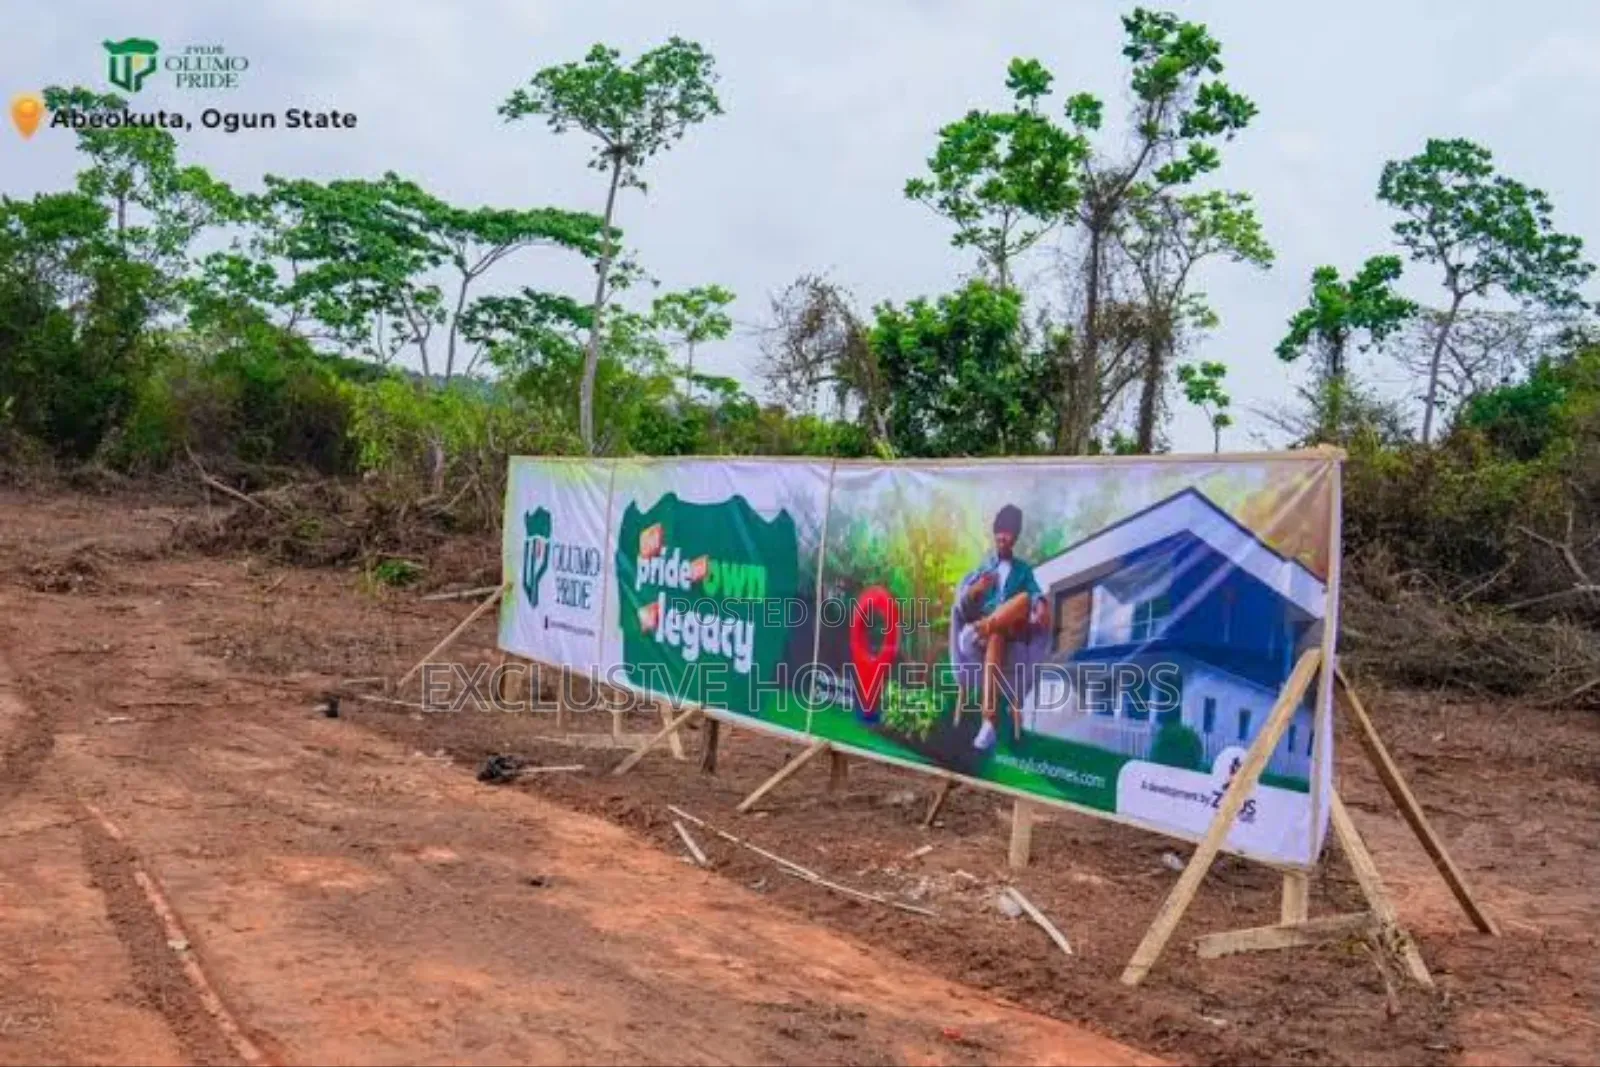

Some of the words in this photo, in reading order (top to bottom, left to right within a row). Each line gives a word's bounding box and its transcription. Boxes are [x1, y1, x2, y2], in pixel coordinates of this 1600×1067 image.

[635, 546, 693, 591] pride
[703, 558, 767, 603] own
[655, 591, 755, 674] legacy
